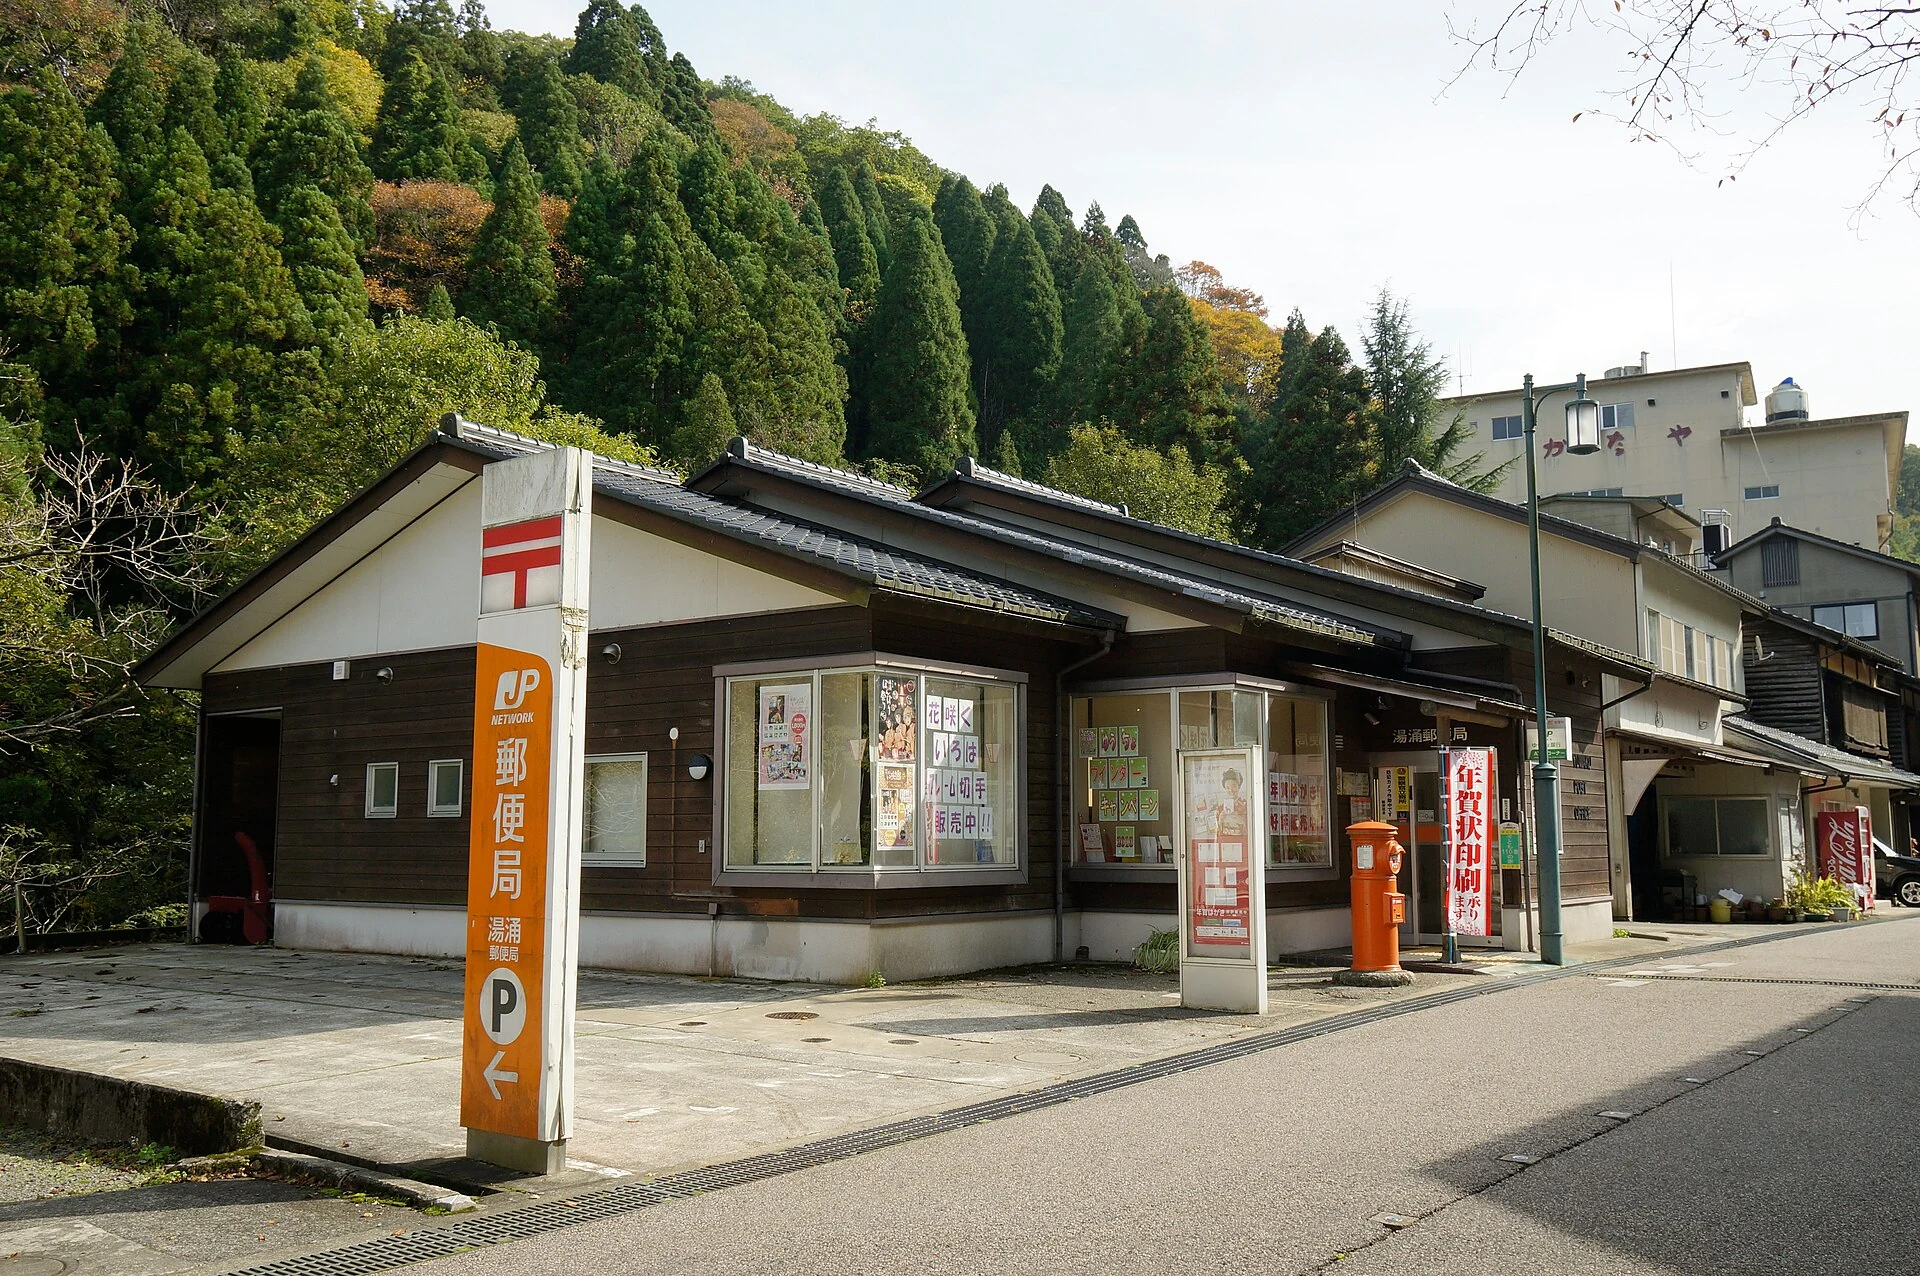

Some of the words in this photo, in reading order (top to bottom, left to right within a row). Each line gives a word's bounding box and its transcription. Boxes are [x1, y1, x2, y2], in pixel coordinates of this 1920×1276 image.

[494, 669, 541, 711] JP
[491, 712, 534, 726] NETWORK
[929, 701, 971, 727] 花咲く
[1102, 732, 1137, 751] ゆうちょ
[1393, 727, 1468, 743] 湯涌郵局
[935, 739, 977, 763] いろは
[491, 738, 528, 900] 郵便局
[1454, 764, 1482, 893] 年賀状印刷
[1453, 895, 1467, 920] ます
[1467, 895, 1481, 920] 承り
[488, 916, 521, 944] 湯涌
[489, 945, 519, 962] 郵便局
[492, 978, 517, 1033] P
